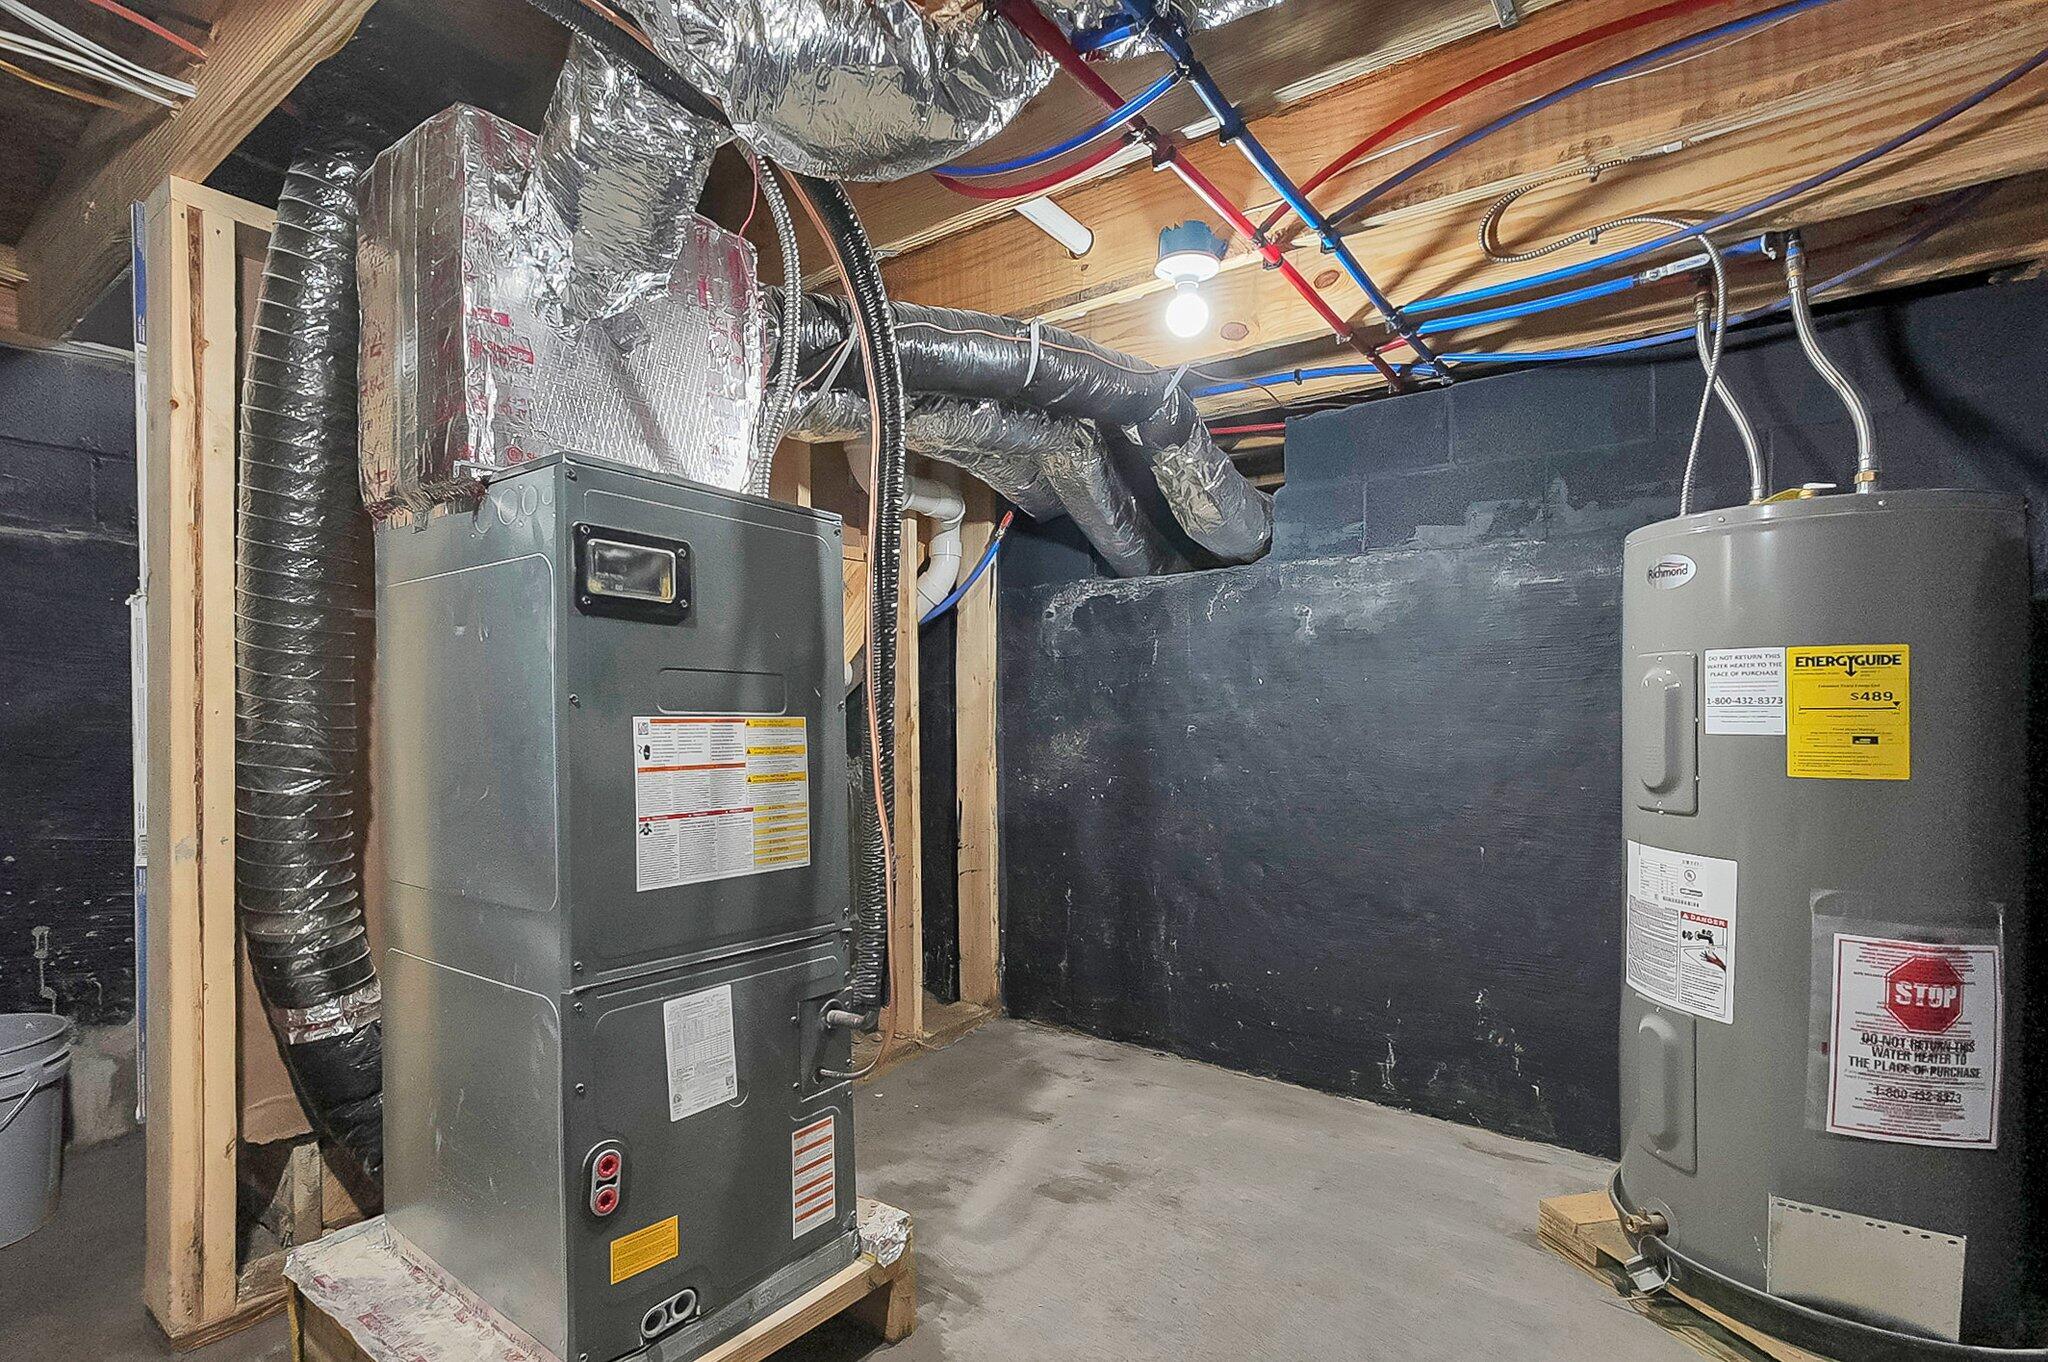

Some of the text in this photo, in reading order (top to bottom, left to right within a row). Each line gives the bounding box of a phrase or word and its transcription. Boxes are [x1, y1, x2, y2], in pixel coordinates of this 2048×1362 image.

[1648, 563, 1688, 579] Richmond
[1795, 654, 1902, 669] ENERGYGUIDE
[1707, 697, 1783, 705] 1-800-432-8373
[1850, 691, 1894, 702] $489
[1690, 913, 1726, 927] DANGER
[1894, 980, 1957, 1008] STOP
[1861, 1033, 1976, 1053] DO NOT RETURN THIS
[1871, 1046, 1967, 1065] WATER HEATER TO
[1848, 1055, 1870, 1068] THE
[1874, 1059, 1910, 1074] PLACE
[1912, 1064, 1927, 1075] OF
[1929, 1065, 1981, 1079] PURCHASE
